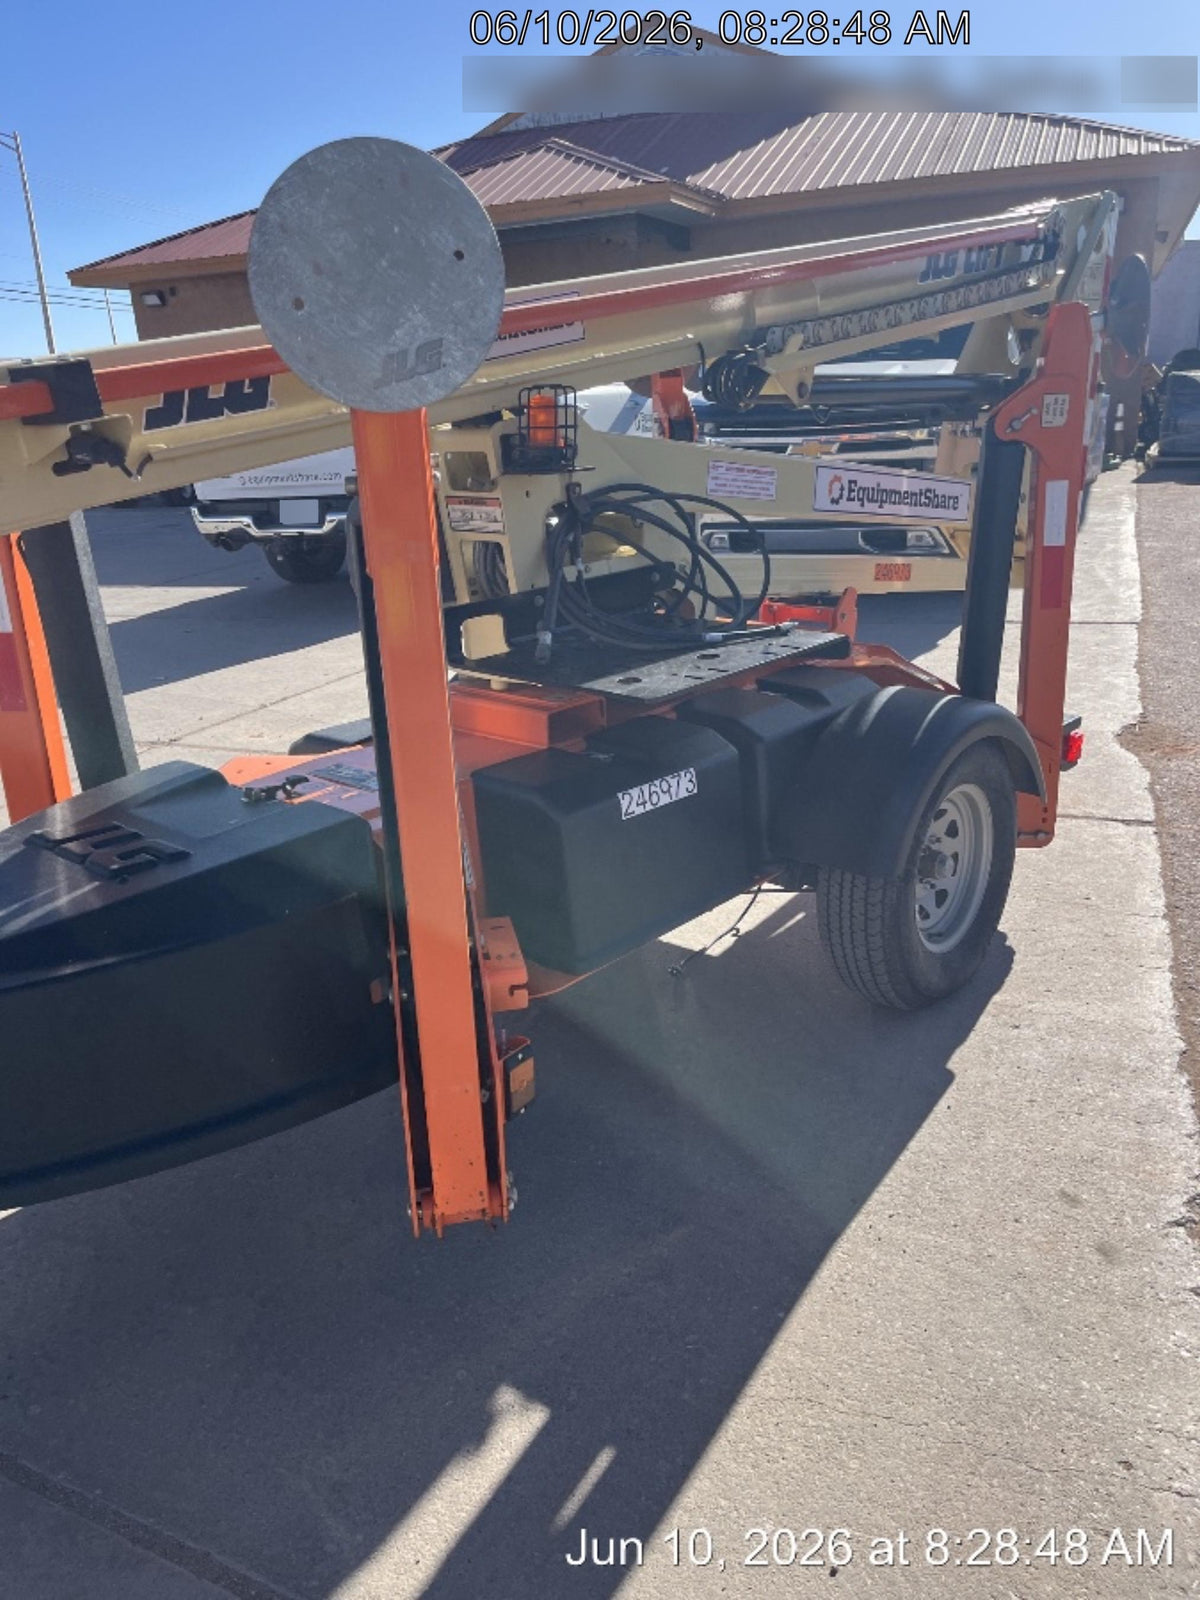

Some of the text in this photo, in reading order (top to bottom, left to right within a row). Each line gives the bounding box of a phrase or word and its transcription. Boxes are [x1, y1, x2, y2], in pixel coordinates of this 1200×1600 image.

[373, 338, 443, 390] JLG
[142, 374, 272, 433] JLG
[845, 479, 960, 511] EquipmentShare
[621, 770, 697, 817] 246973
